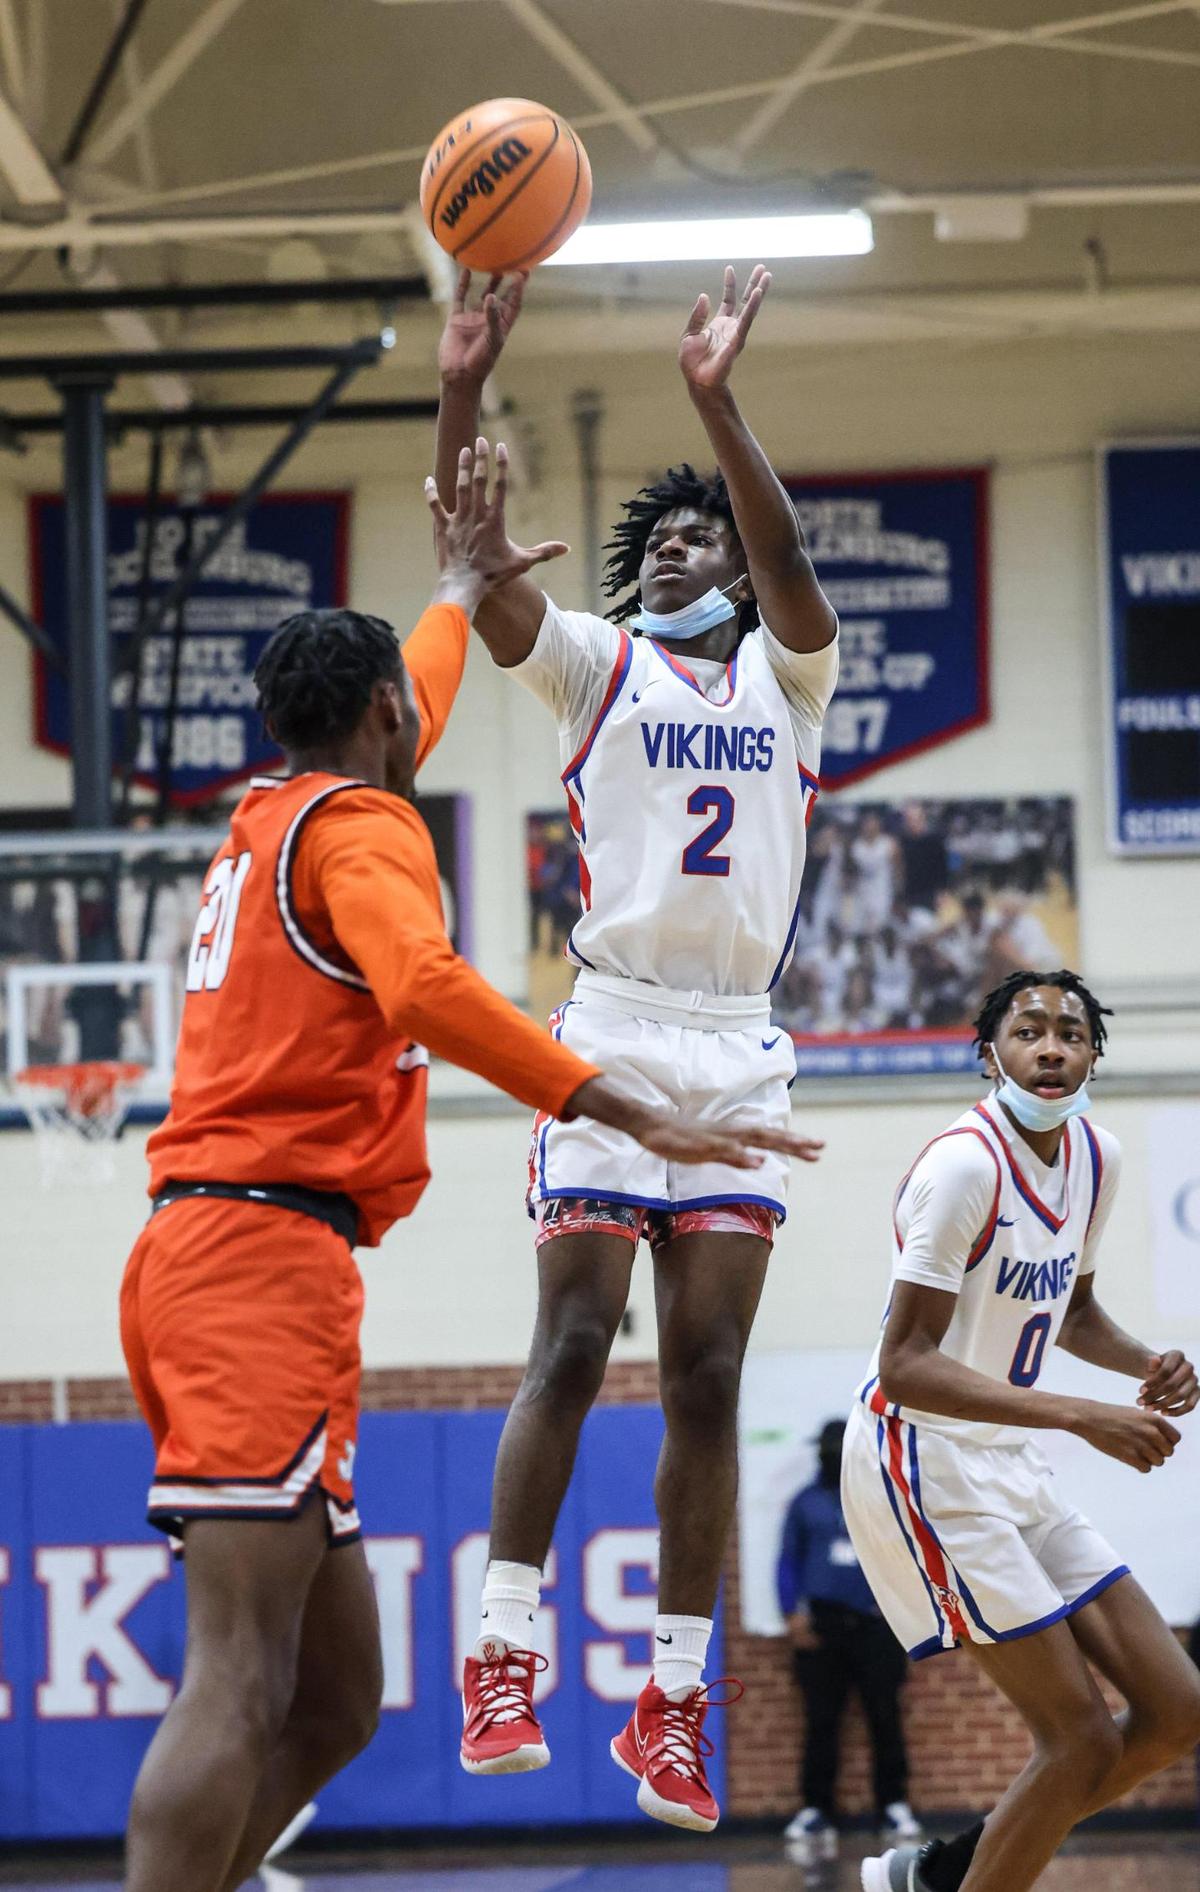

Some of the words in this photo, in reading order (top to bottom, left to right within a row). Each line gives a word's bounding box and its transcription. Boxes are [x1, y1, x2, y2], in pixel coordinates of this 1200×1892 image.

[440, 137, 533, 230] Wilson
[641, 722, 775, 772] VIKINGS
[681, 785, 735, 876] 2
[1008, 1312, 1051, 1388] 0
